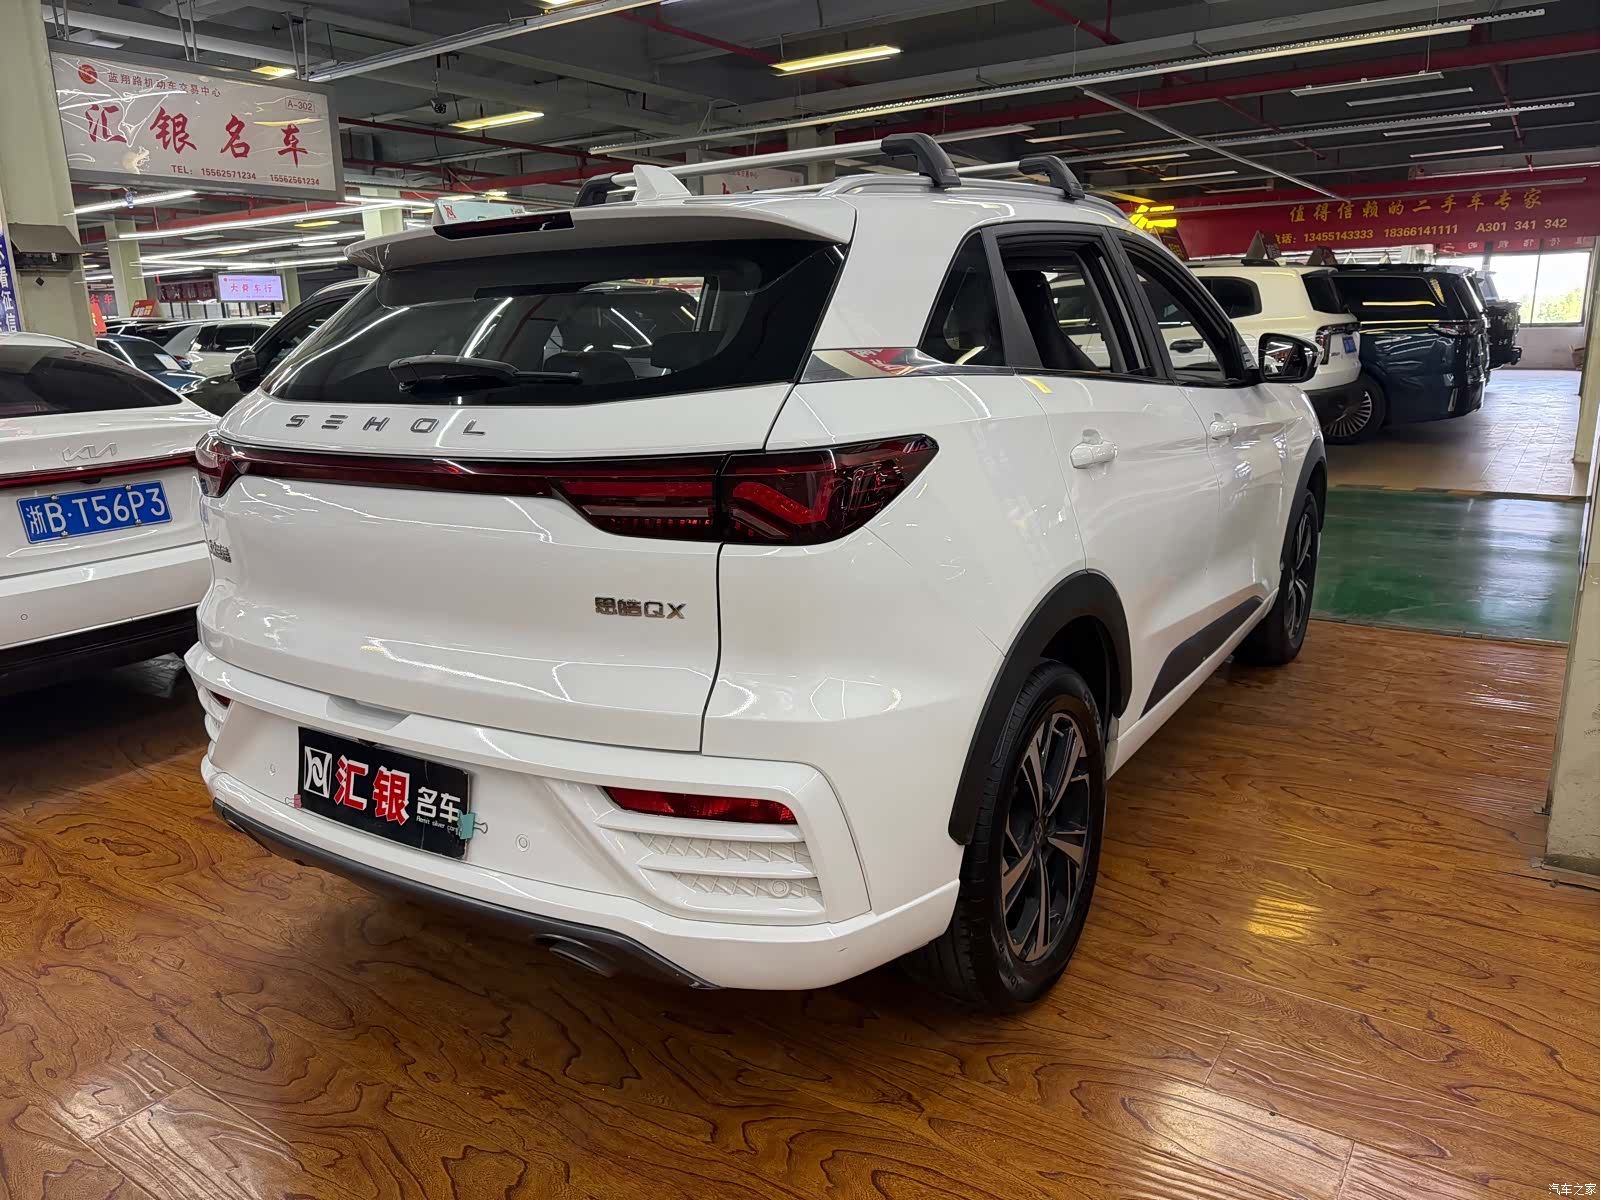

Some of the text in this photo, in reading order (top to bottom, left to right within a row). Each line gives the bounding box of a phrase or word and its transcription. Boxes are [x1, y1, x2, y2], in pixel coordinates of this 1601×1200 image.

[106, 71, 221, 98] 蓝翔路机动车交易中心
[287, 99, 313, 111] A-302
[85, 103, 309, 168] 汇银名车
[200, 168, 257, 180] 15562571234
[269, 174, 320, 186] 15562561234
[1289, 187, 1542, 223] 值得信赖的二手车专家
[1303, 229, 1374, 243] 13455143333
[1384, 224, 1458, 239] 18366141111
[1476, 221, 1507, 233] A301
[1514, 220, 1537, 231] 341
[1544, 218, 1568, 229] 342
[286, 413, 486, 436] SEHOL
